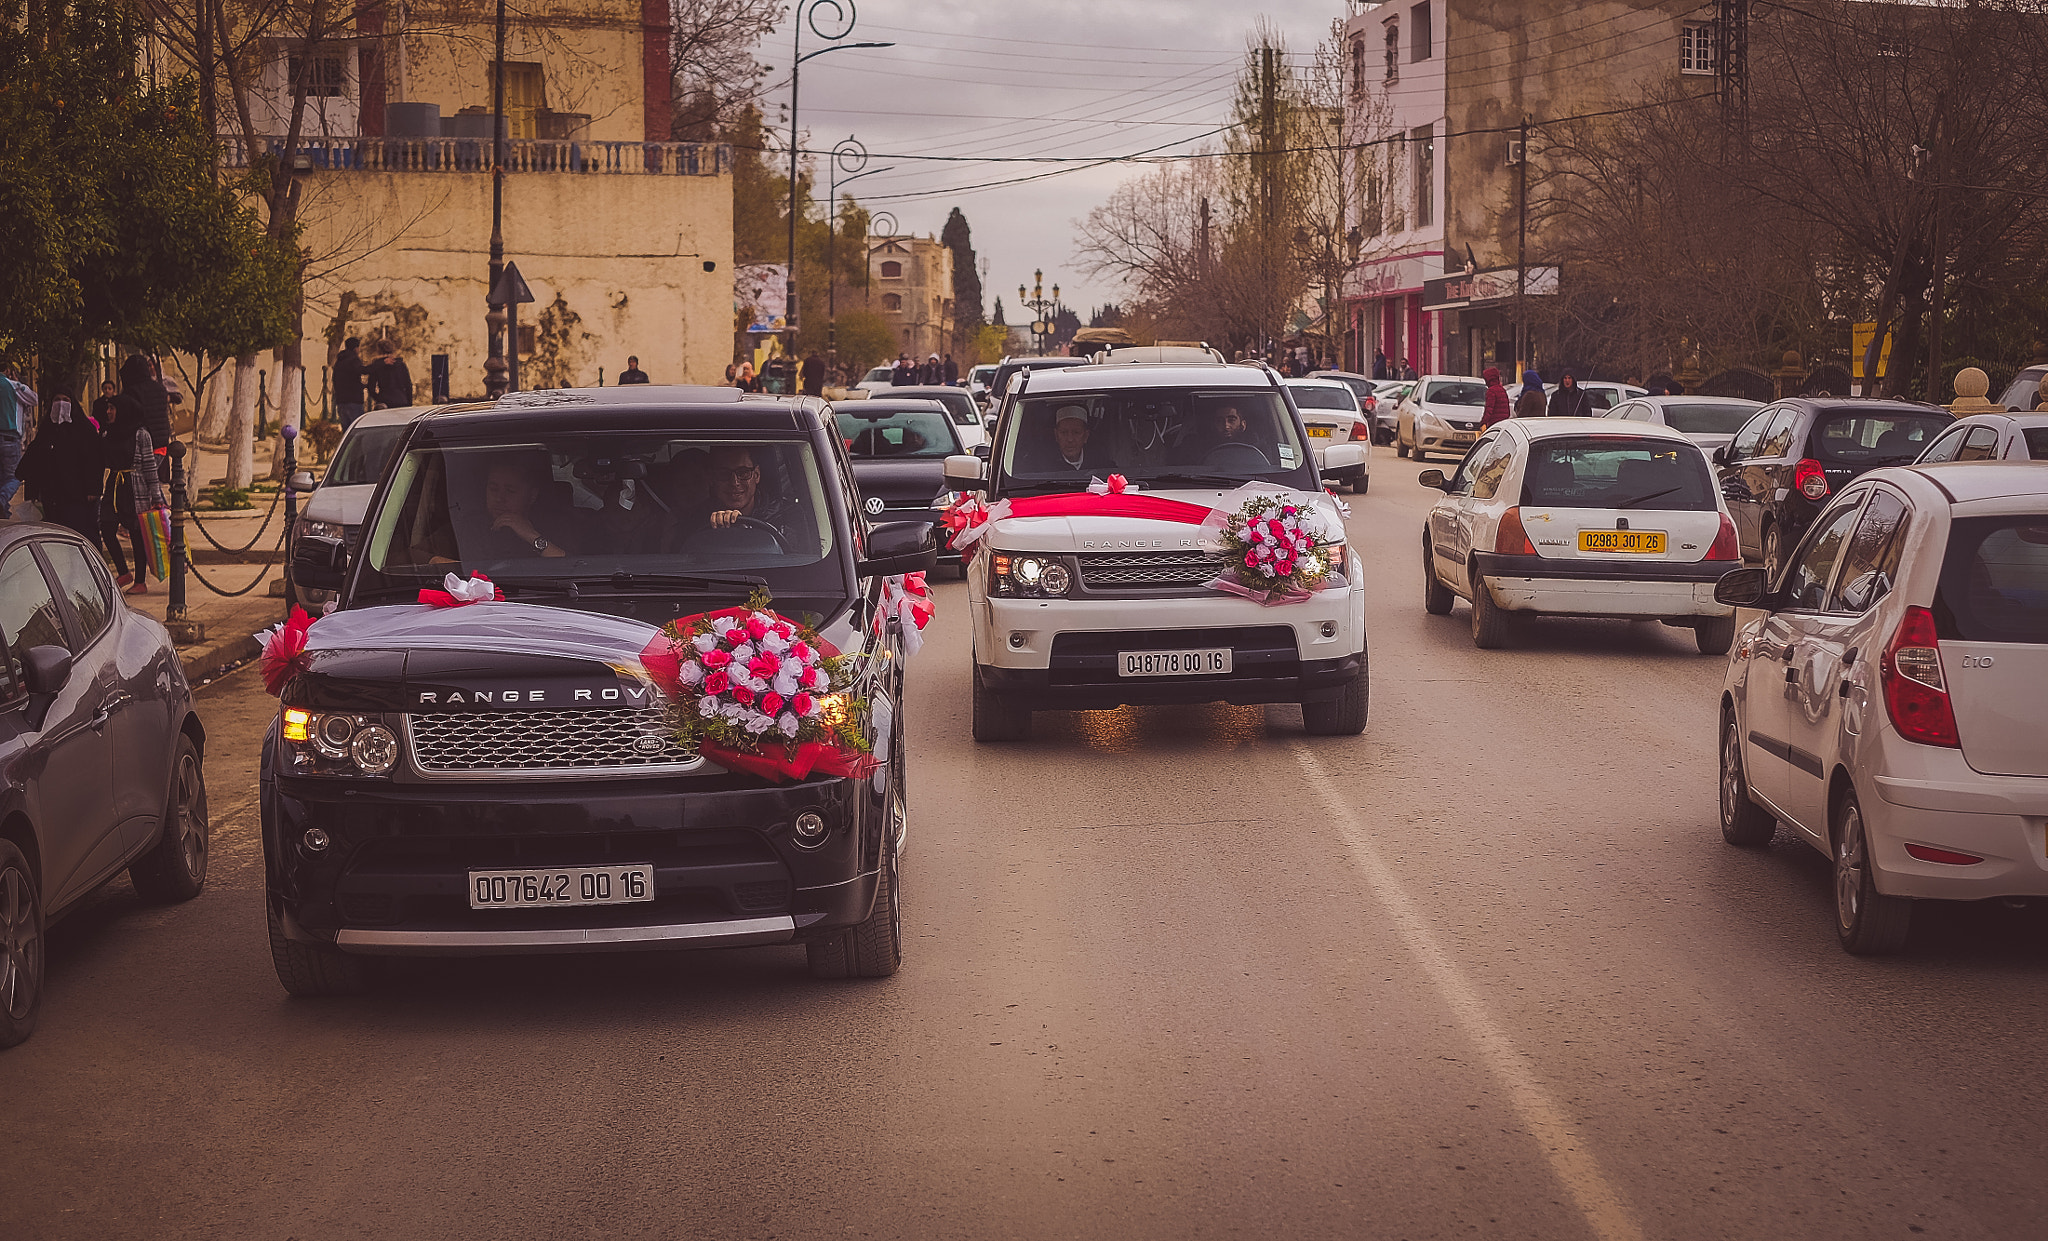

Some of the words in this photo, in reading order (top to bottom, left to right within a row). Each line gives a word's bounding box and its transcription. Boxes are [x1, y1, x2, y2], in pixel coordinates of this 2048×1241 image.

[1083, 539, 1163, 549] RANGE
[1179, 539, 1224, 548] ROV
[1586, 533, 1618, 548] 02983
[1622, 534, 1641, 548] 301
[1645, 535, 1658, 549] 26
[1127, 654, 1179, 673] 018778
[1184, 653, 1201, 672] 00
[1207, 652, 1223, 671] 16
[419, 690, 545, 704] RANGE
[574, 687, 667, 702] ROV
[475, 875, 571, 903] 007642
[580, 873, 611, 900] 00
[619, 871, 645, 898] 16
